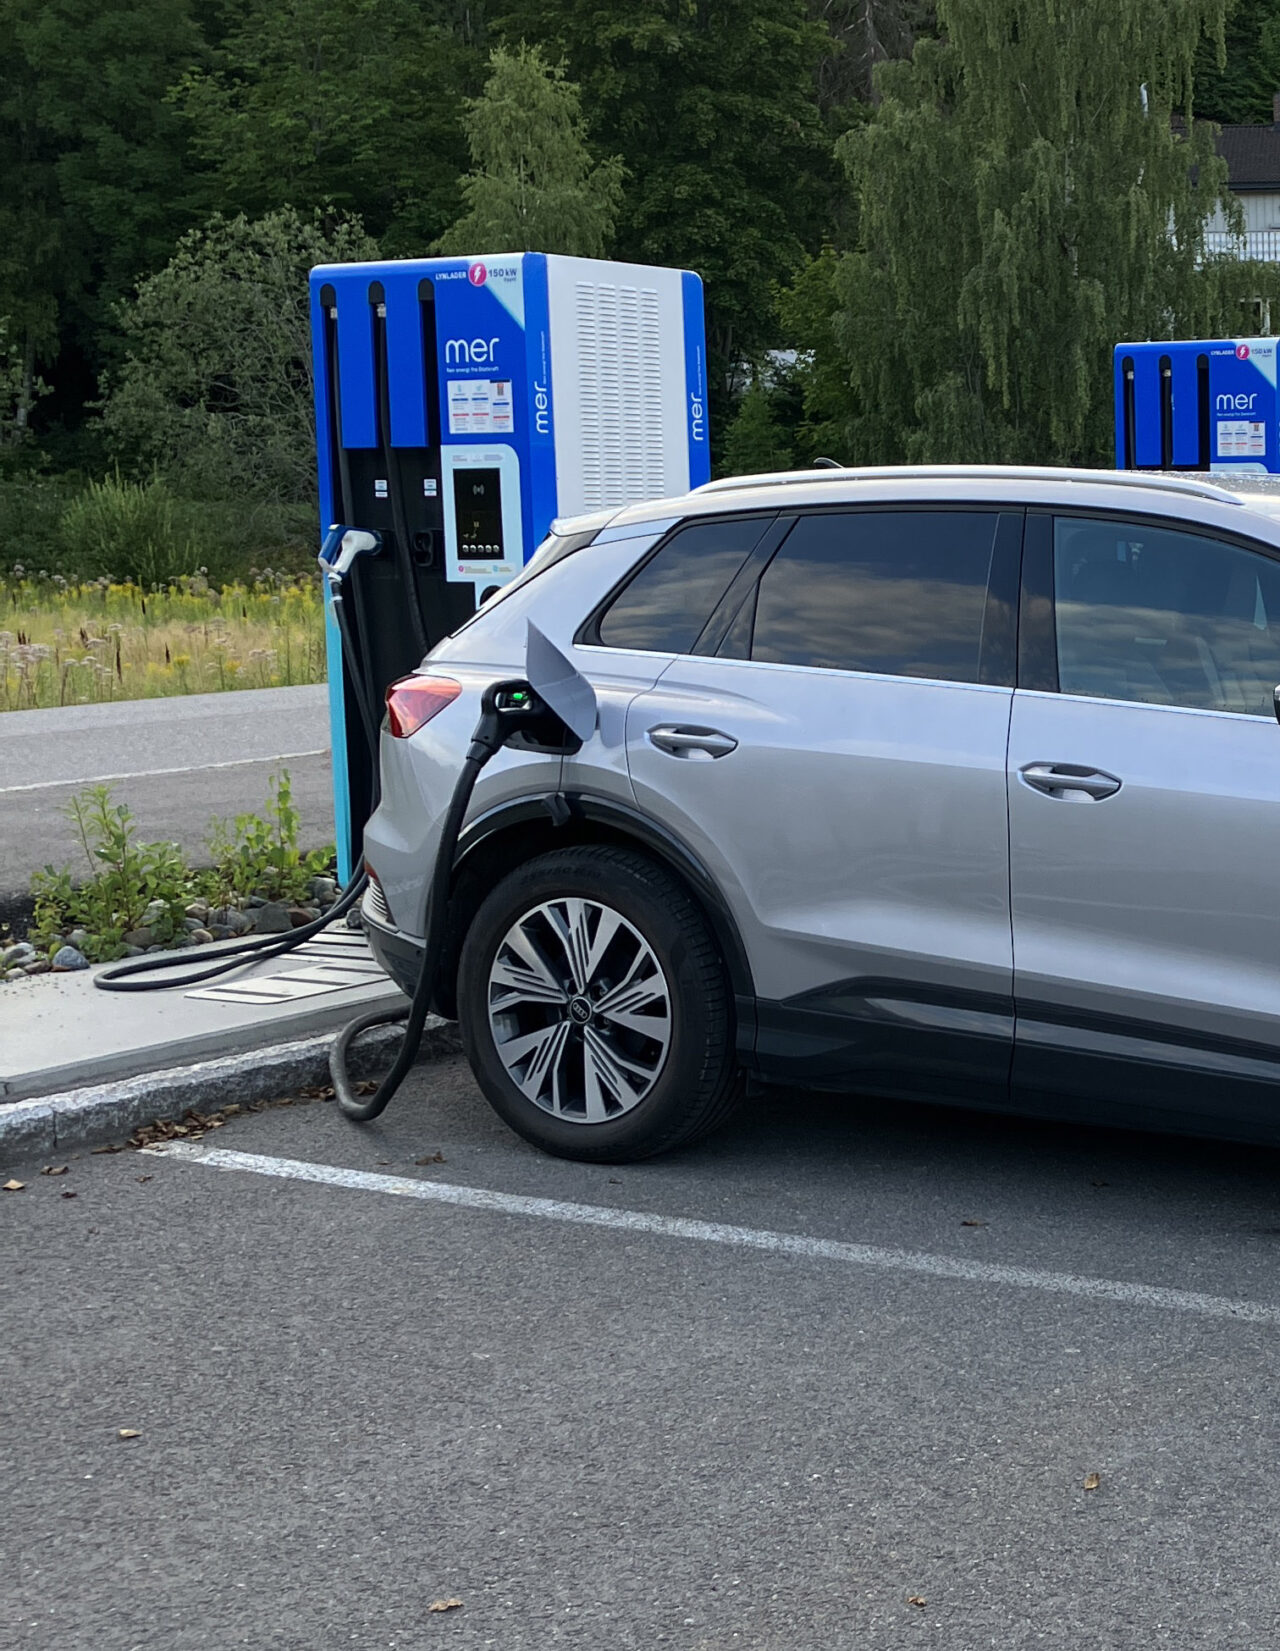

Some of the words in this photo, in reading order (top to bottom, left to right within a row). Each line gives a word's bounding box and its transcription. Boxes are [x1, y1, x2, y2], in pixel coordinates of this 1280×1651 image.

[488, 268, 504, 278] 150
[505, 268, 518, 277] kW
[445, 337, 500, 364] mer
[534, 380, 549, 434] mer
[1216, 393, 1258, 410] mer
[690, 391, 704, 441] mer
